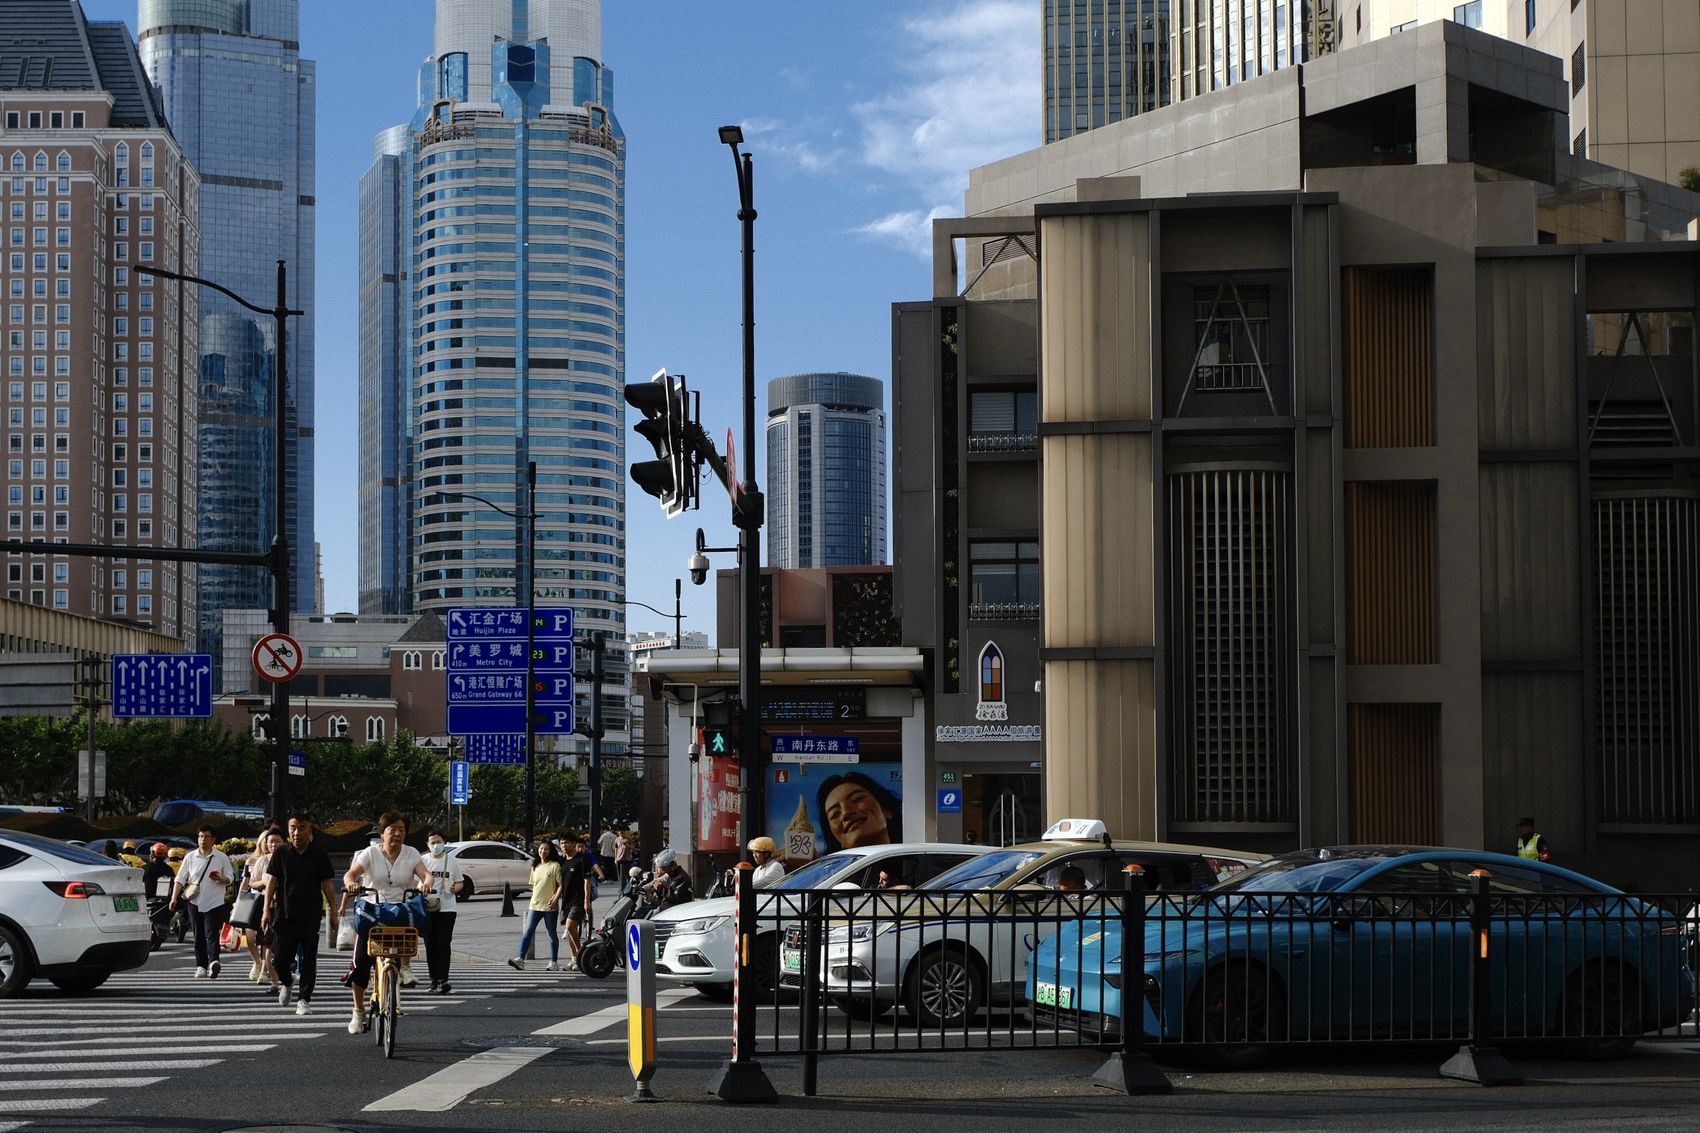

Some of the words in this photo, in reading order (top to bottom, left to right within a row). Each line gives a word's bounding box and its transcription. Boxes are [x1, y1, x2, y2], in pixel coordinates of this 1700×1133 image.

[469, 612, 522, 625] 汇金广场
[554, 615, 567, 631] P
[474, 628, 494, 636] Huijin
[469, 644, 522, 657] 美罗城
[533, 651, 543, 659] 23
[554, 647, 567, 663] P
[499, 659, 513, 667] City
[468, 676, 523, 689] 港汇恒隆广场
[554, 679, 567, 695] P
[488, 691, 512, 699] Gateway
[841, 705, 849, 718] 2
[554, 711, 567, 727] P
[792, 739, 839, 752] 南丹东路
